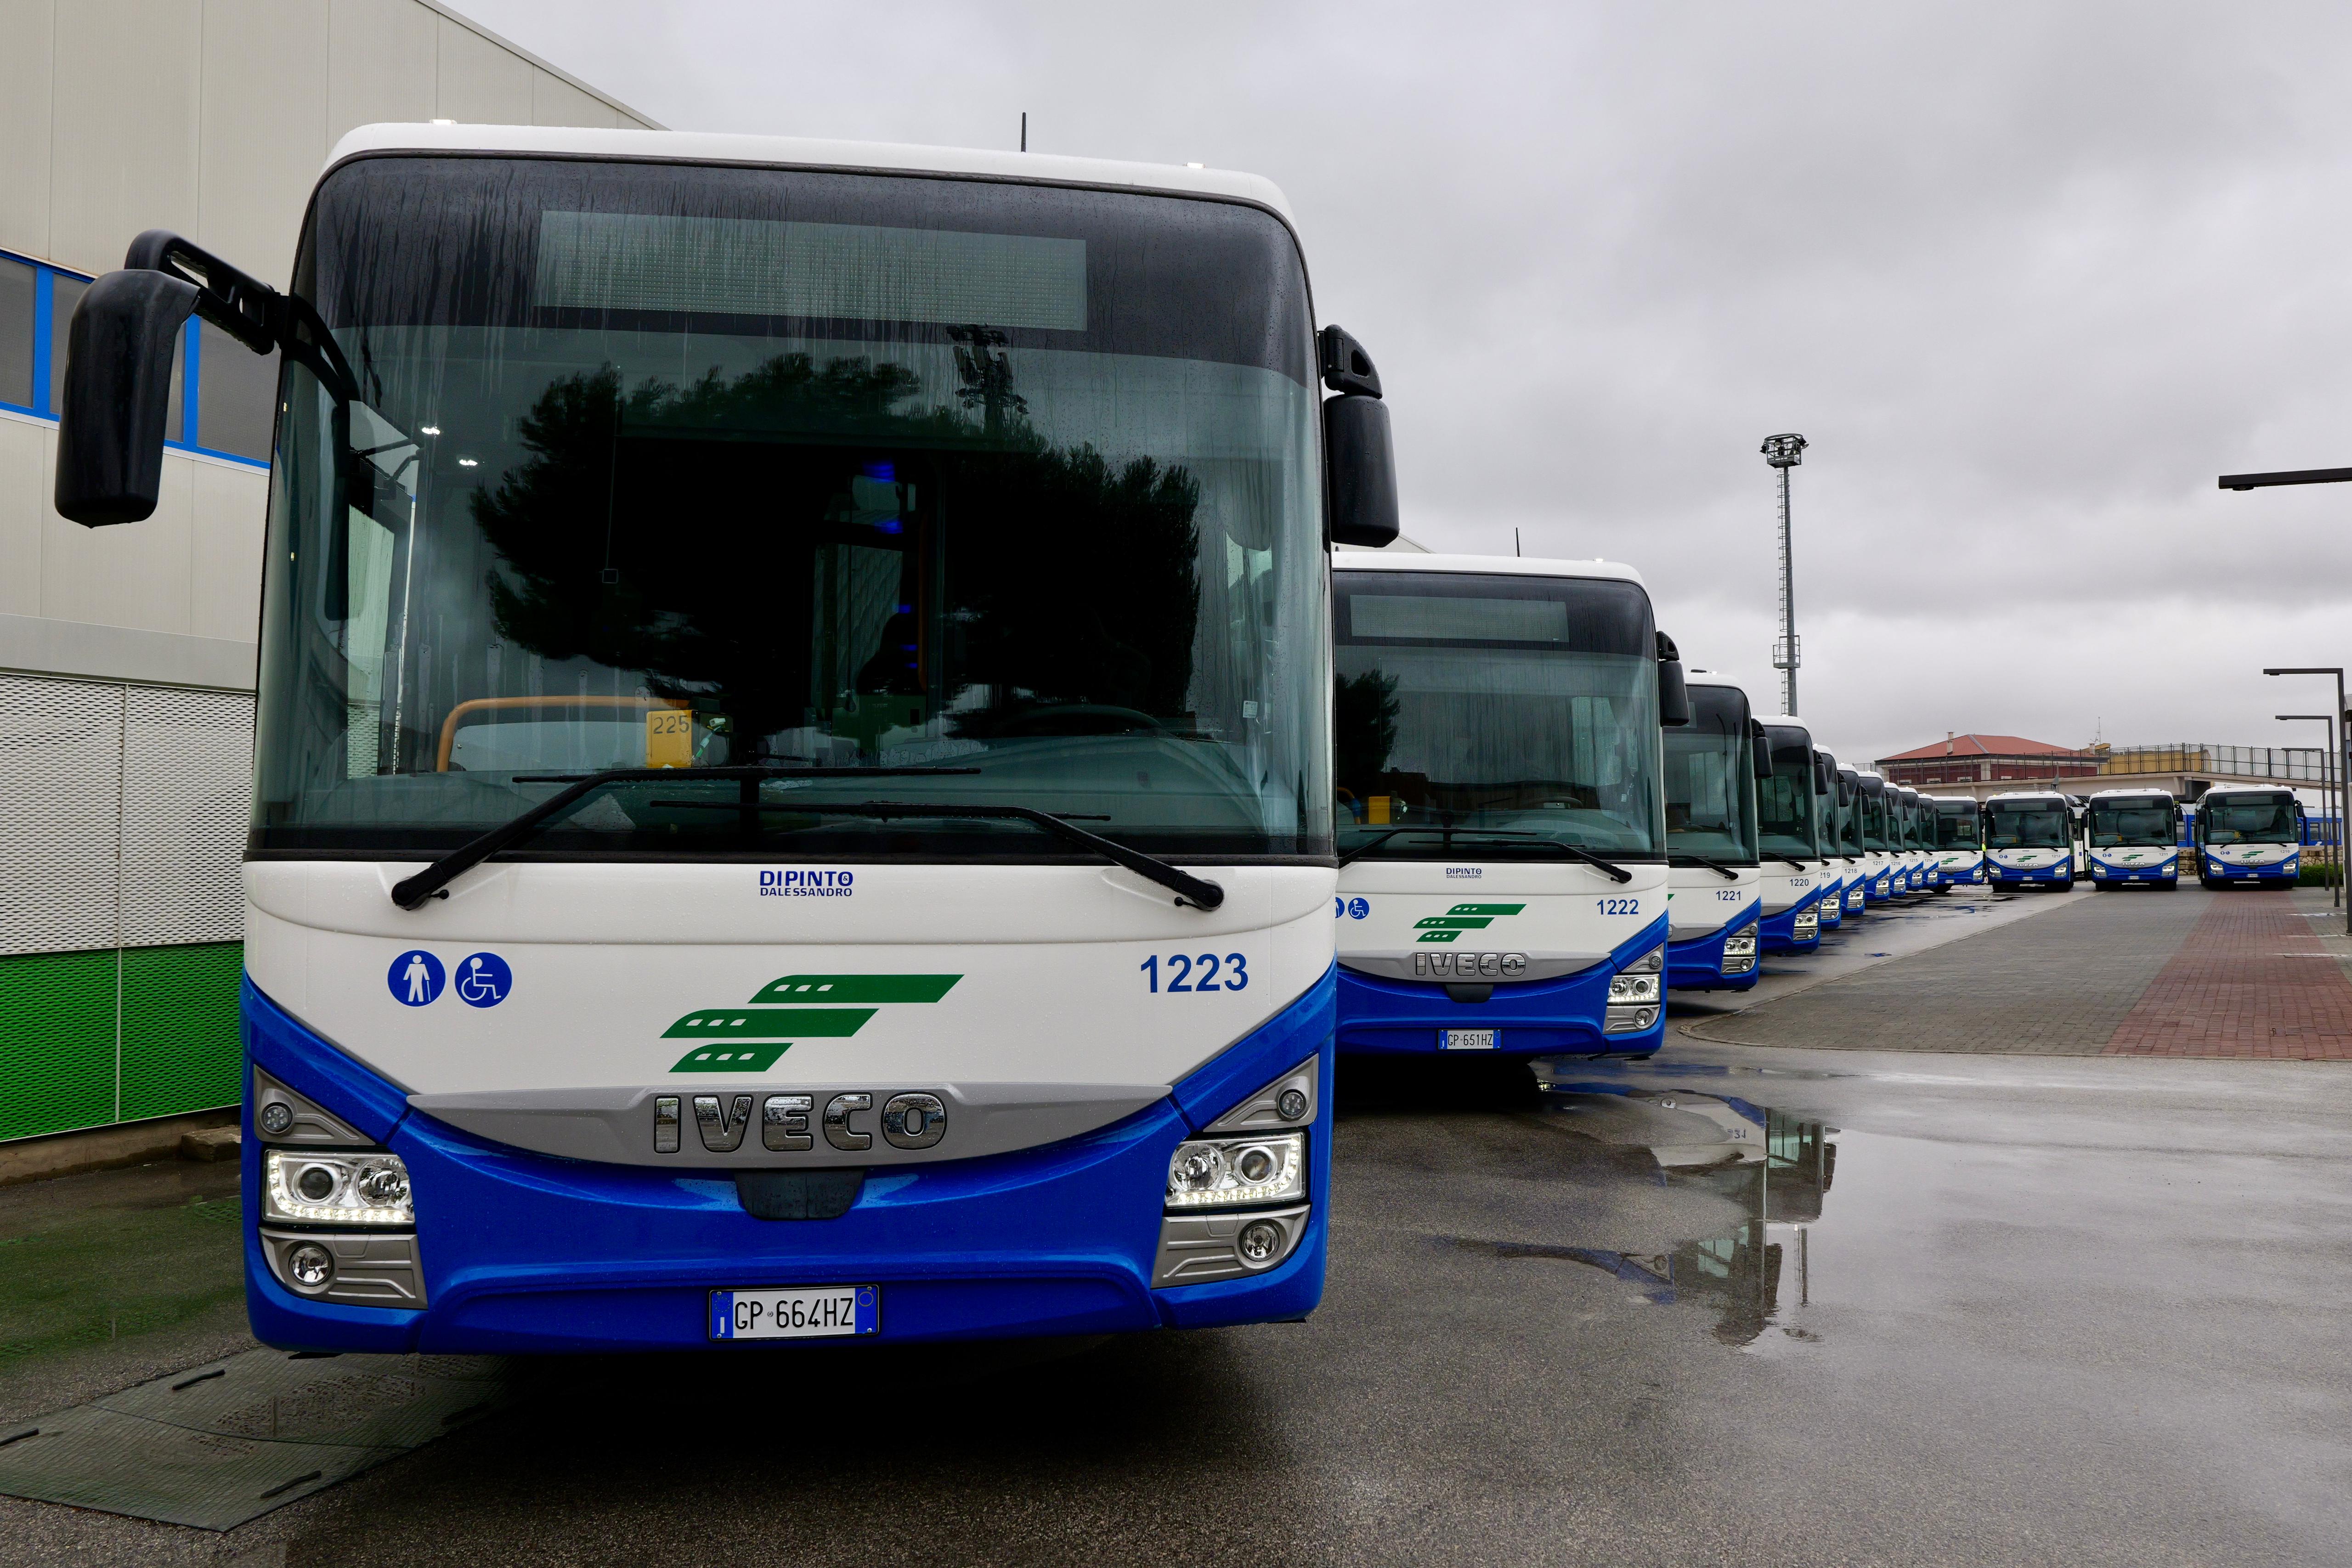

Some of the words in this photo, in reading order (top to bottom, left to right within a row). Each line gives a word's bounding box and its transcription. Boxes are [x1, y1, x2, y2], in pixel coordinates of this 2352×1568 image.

[654, 715, 690, 734] 225
[759, 870, 854, 886] DIPINTO
[760, 887, 853, 897] DALESSANDRO
[1716, 891, 1741, 901] 1221
[1597, 898, 1639, 915] 1222
[1141, 953, 1249, 993] 1223
[1415, 953, 1527, 977] IVECO
[1448, 1034, 1459, 1046] GP
[654, 1091, 948, 1154] IVECO
[735, 1301, 764, 1330] GP
